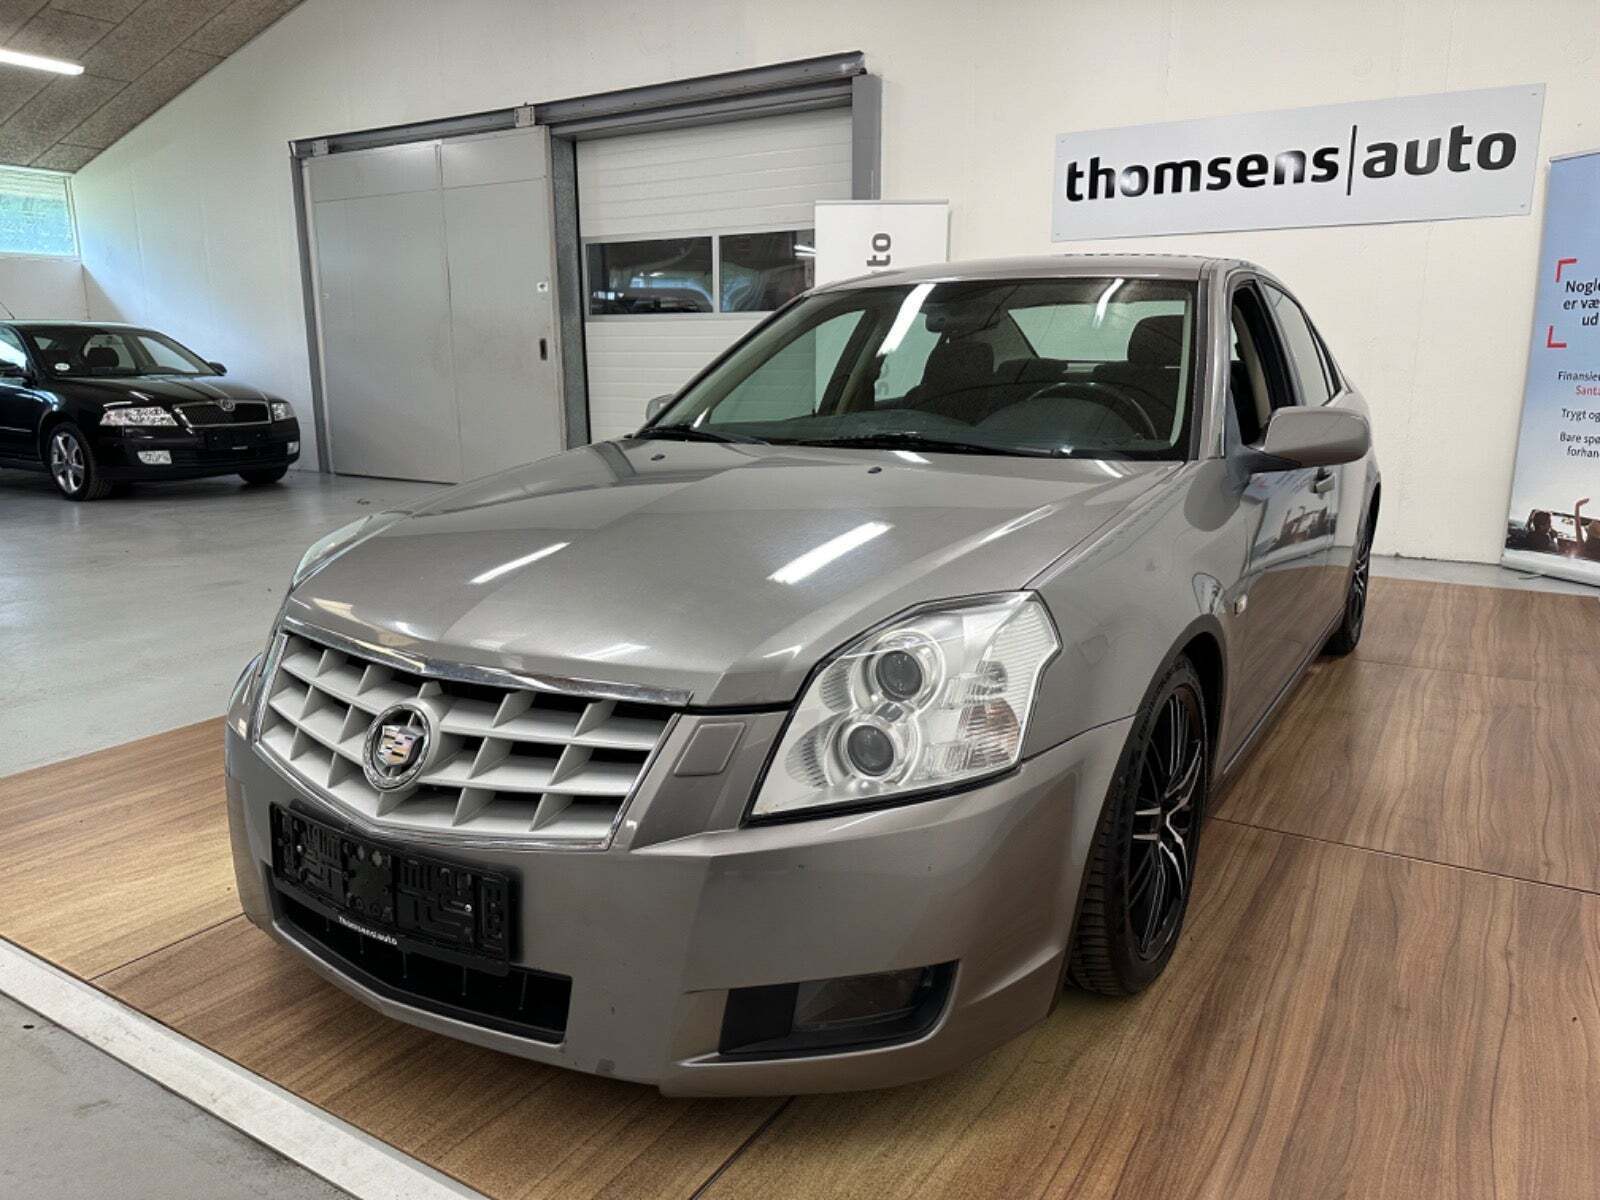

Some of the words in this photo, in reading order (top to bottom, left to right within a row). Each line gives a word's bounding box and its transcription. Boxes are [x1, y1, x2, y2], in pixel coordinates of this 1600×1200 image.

[1362, 124, 1517, 179] auto
[1565, 278, 1600, 296] Nogl
[1563, 299, 1578, 310] er
[1582, 312, 1599, 326] ud
